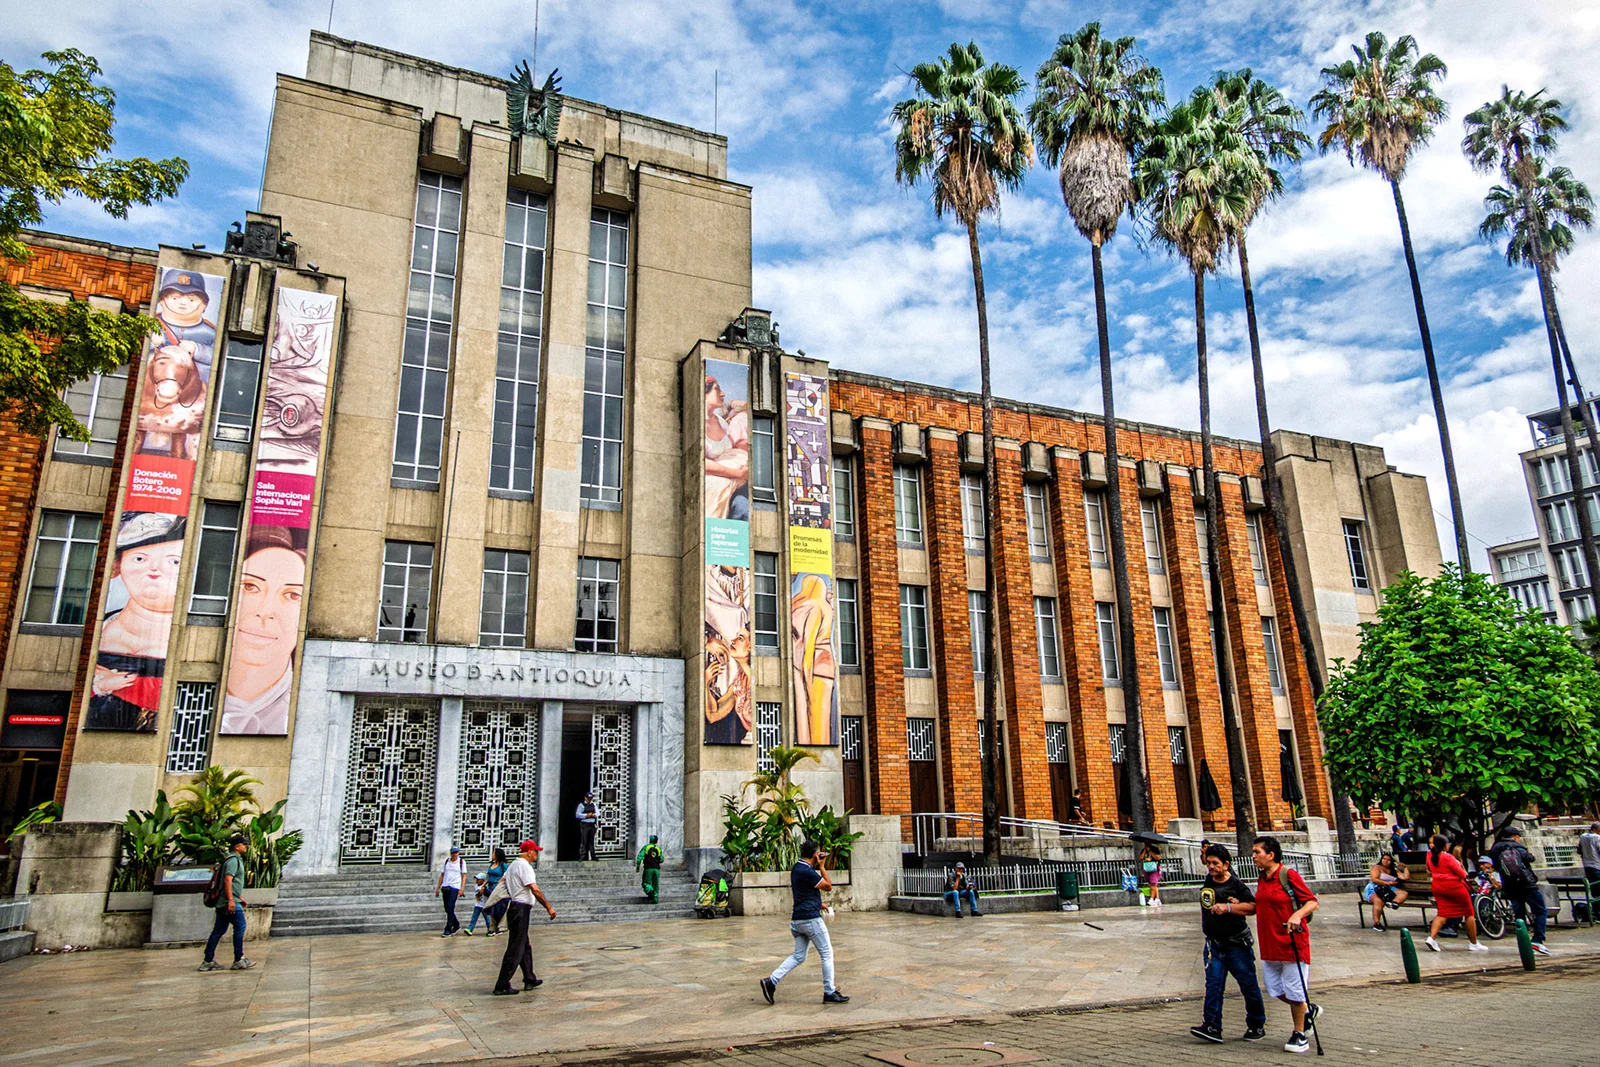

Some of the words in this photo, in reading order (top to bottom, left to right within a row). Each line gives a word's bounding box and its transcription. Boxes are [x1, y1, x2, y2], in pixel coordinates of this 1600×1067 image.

[134, 468, 178, 480] Donación
[132, 476, 163, 486] Botero
[256, 481, 275, 490] Sala
[132, 484, 182, 496] 1974-2008
[255, 489, 311, 501] Internacional
[254, 496, 284, 505] Sophia
[285, 498, 303, 507] Vari
[793, 534, 823, 543] Promesas
[793, 547, 829, 555] modernidad
[371, 660, 457, 679] MUSEO
[492, 666, 631, 688] ANTIOQUIA
